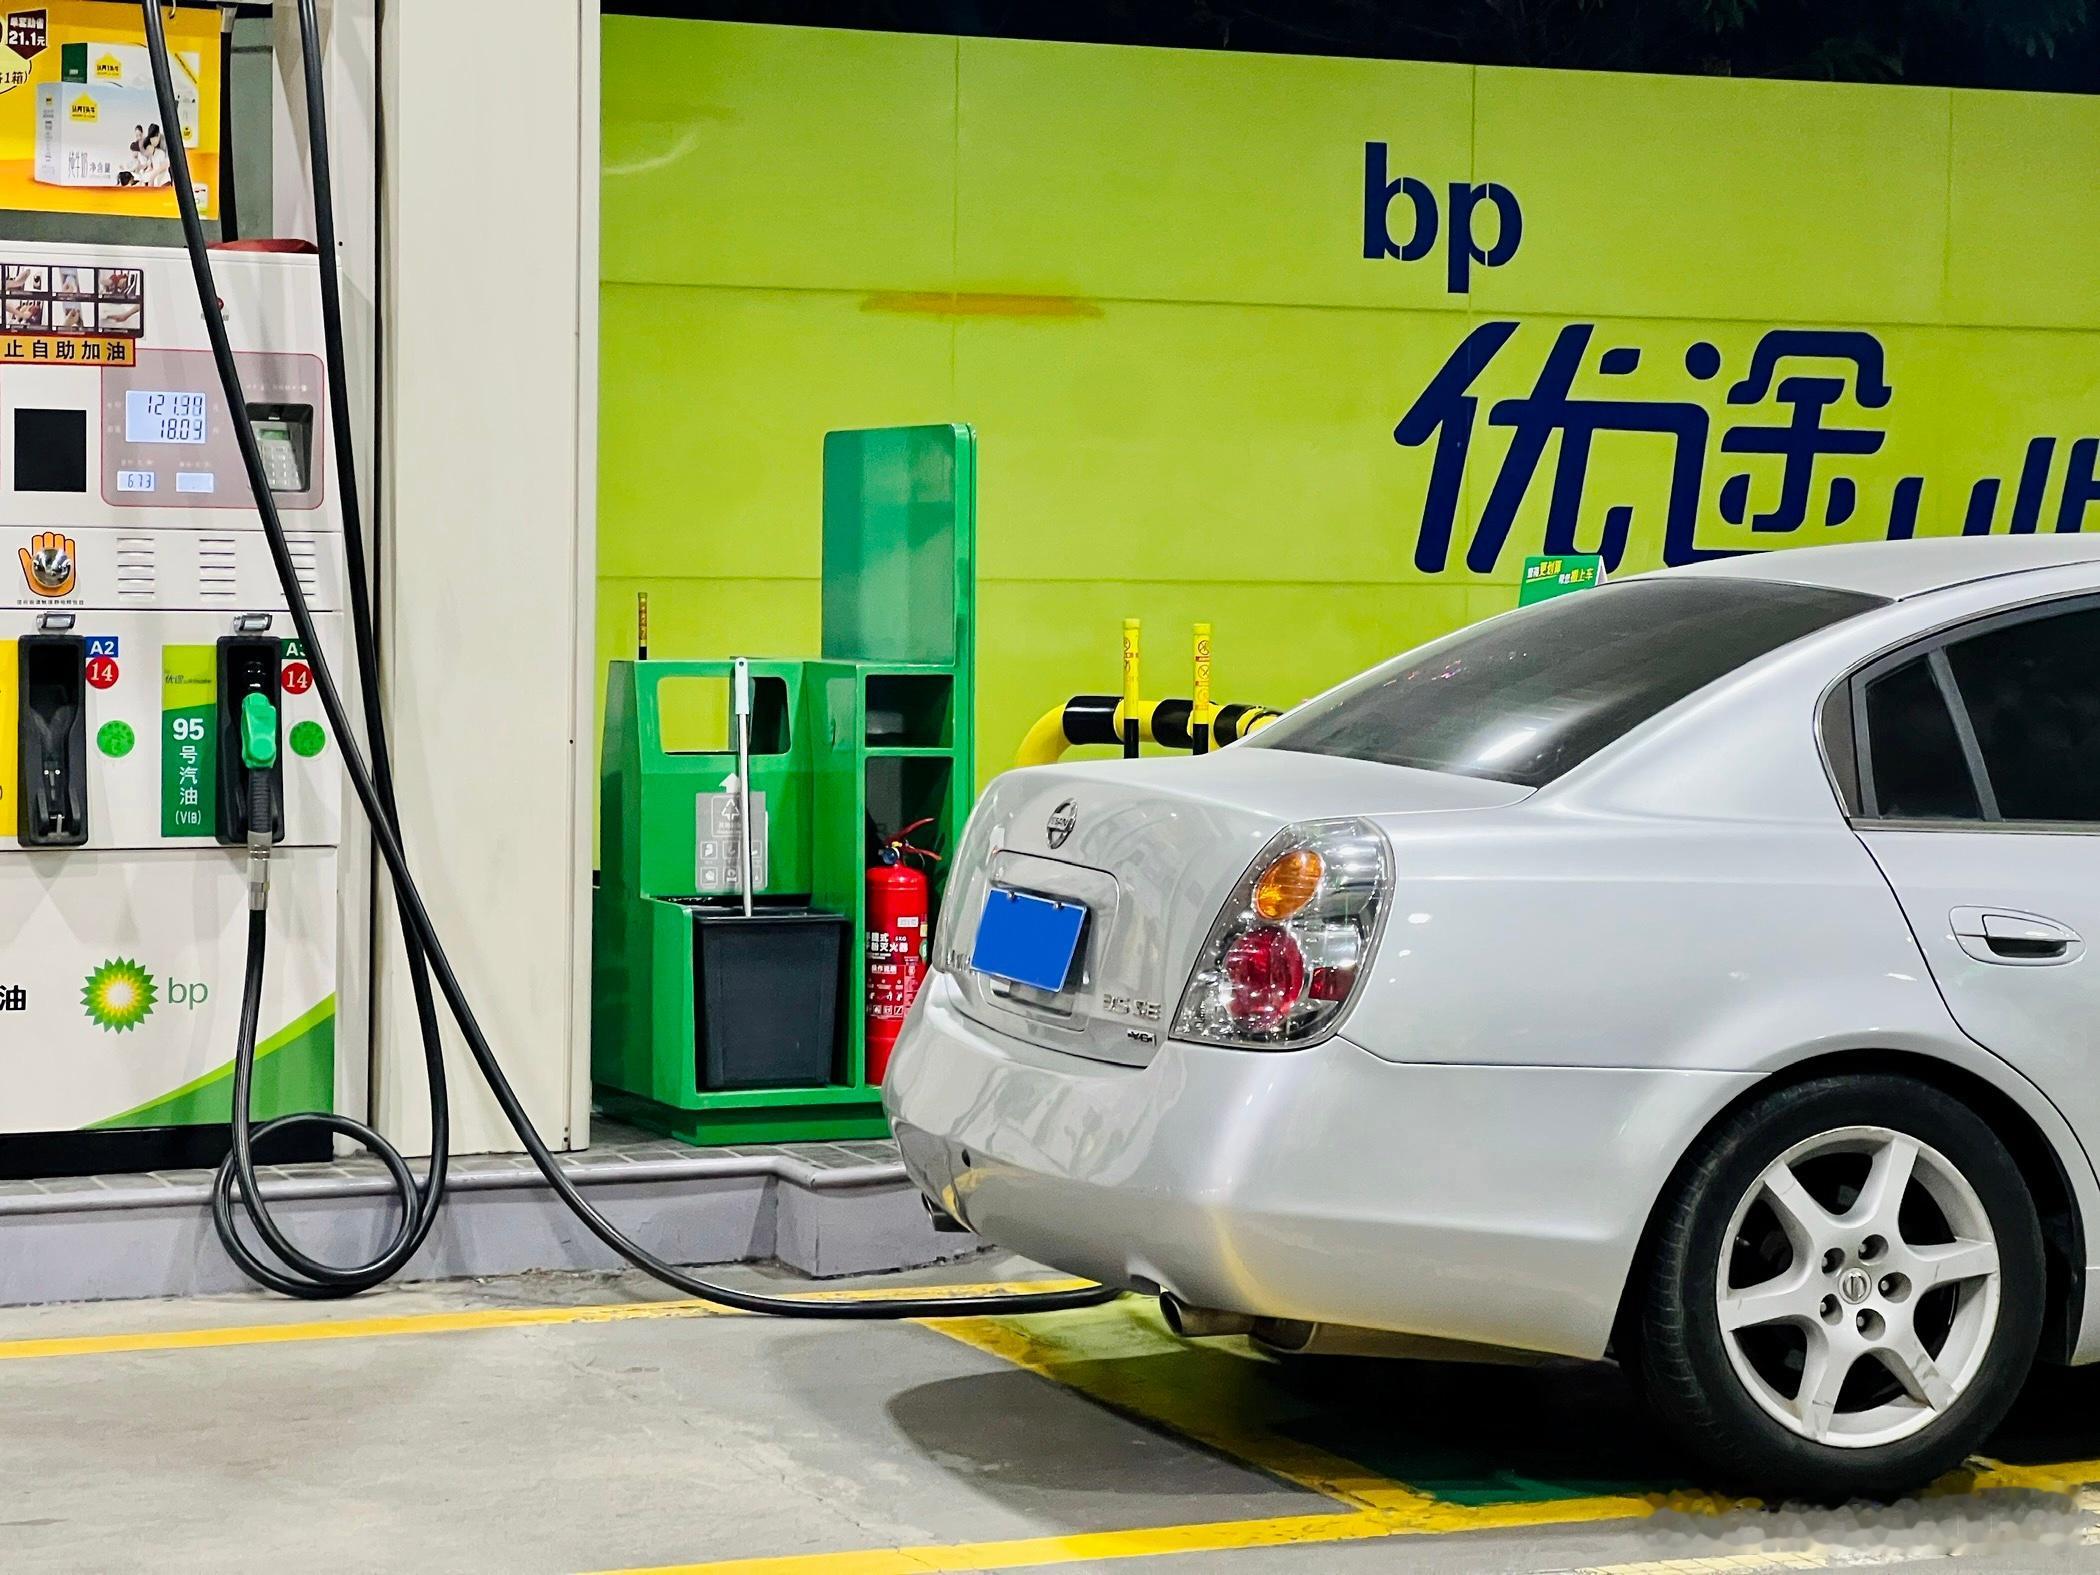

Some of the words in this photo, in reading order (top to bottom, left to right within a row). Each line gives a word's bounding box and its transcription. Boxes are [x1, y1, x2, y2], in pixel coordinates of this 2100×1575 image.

[8, 30, 46, 46] 21.1元
[0, 71, 28, 84] 1箱)
[1363, 142, 1523, 294] bp
[4, 339, 126, 361] 止自助加油
[90, 640, 114, 655] A2
[91, 661, 113, 682] 14
[287, 670, 308, 688] 14
[173, 718, 205, 740] 95
[179, 745, 198, 805] 号汽油
[168, 977, 209, 1010] bp
